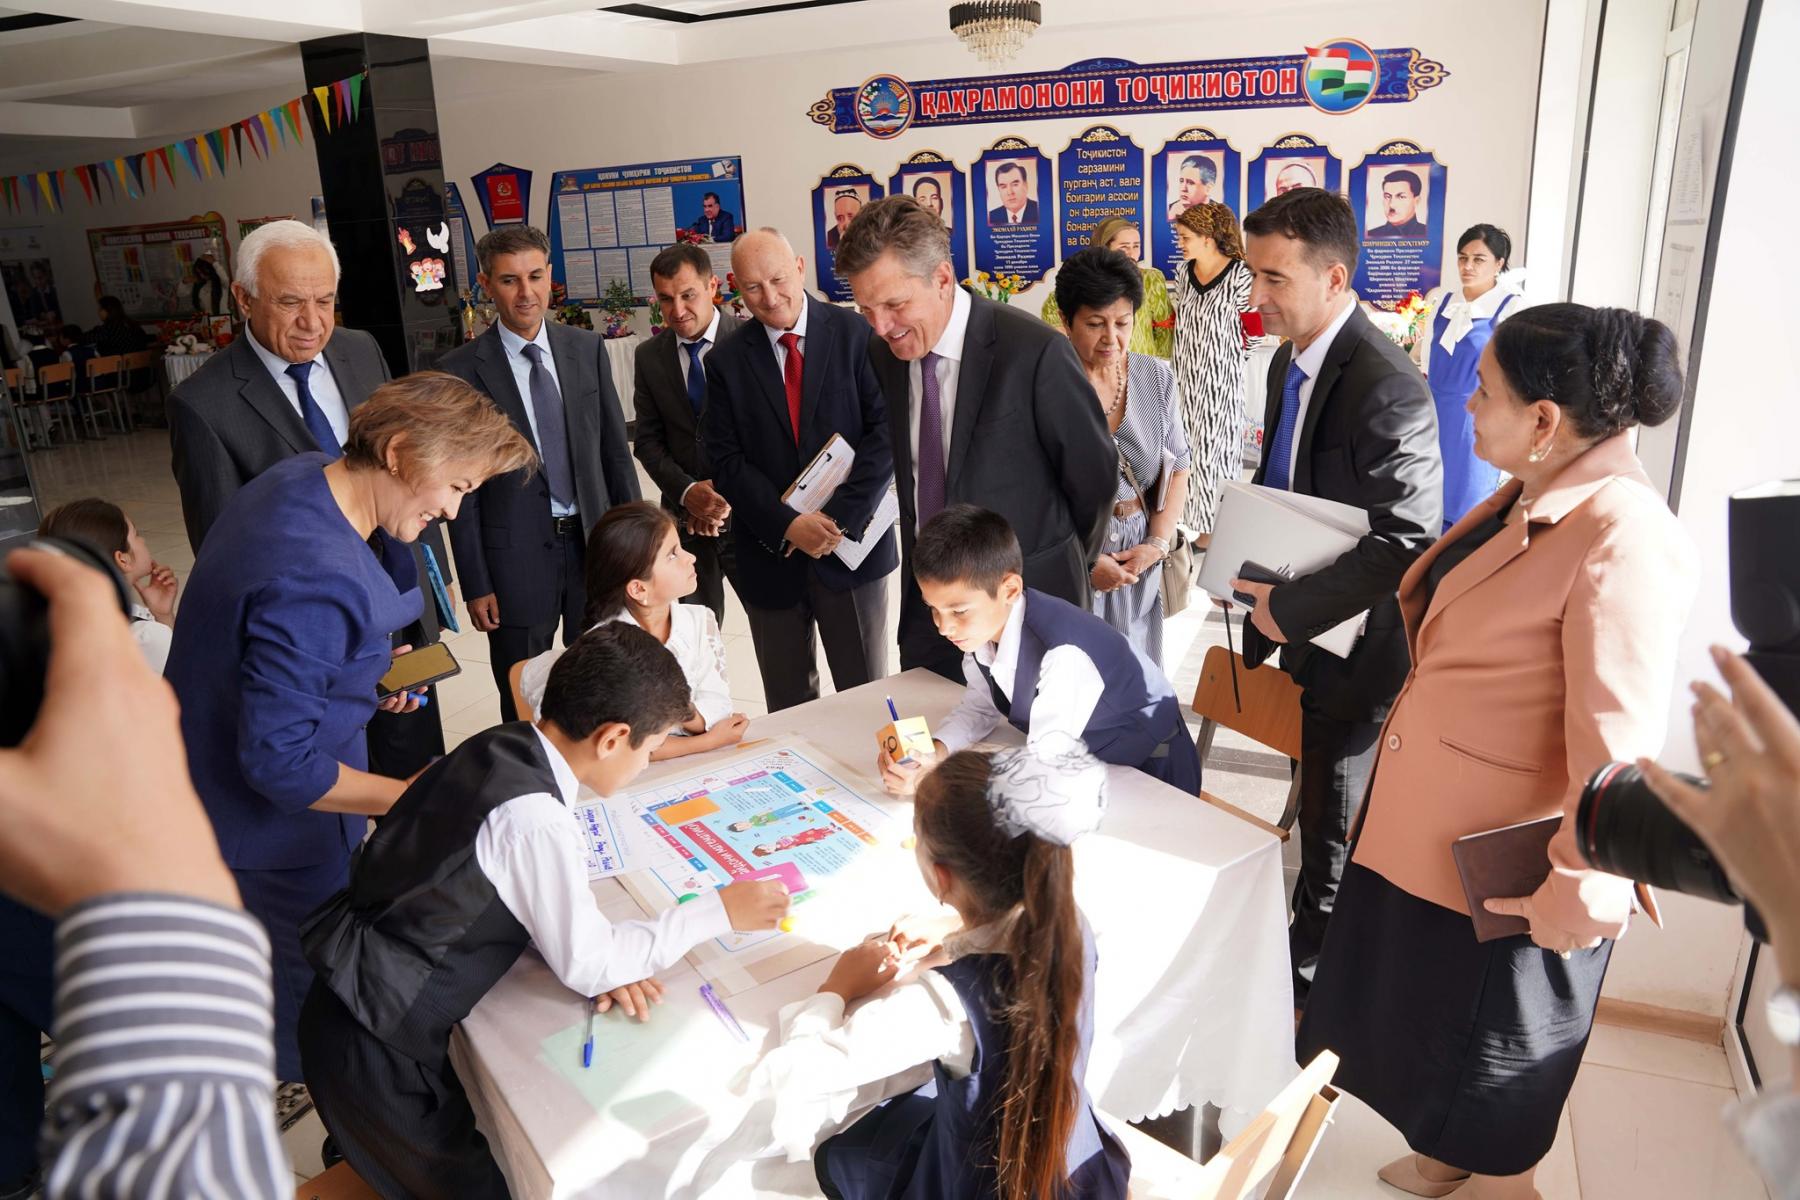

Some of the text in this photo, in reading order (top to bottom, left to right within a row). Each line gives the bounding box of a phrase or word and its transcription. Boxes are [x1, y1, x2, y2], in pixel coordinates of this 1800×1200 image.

[920, 67, 1298, 118] ҚАҲРАМОНОНИ ТОҶИКИСТОН
[1076, 148, 1126, 160] Тоҷикистон
[1078, 163, 1125, 175] сарзамини
[1063, 179, 1098, 191] пурганҷ
[1119, 177, 1140, 186] вале
[1065, 192, 1138, 203] боигарии асосии
[1069, 206, 1136, 218] он фарзандони
[1067, 237, 1077, 246] ва
